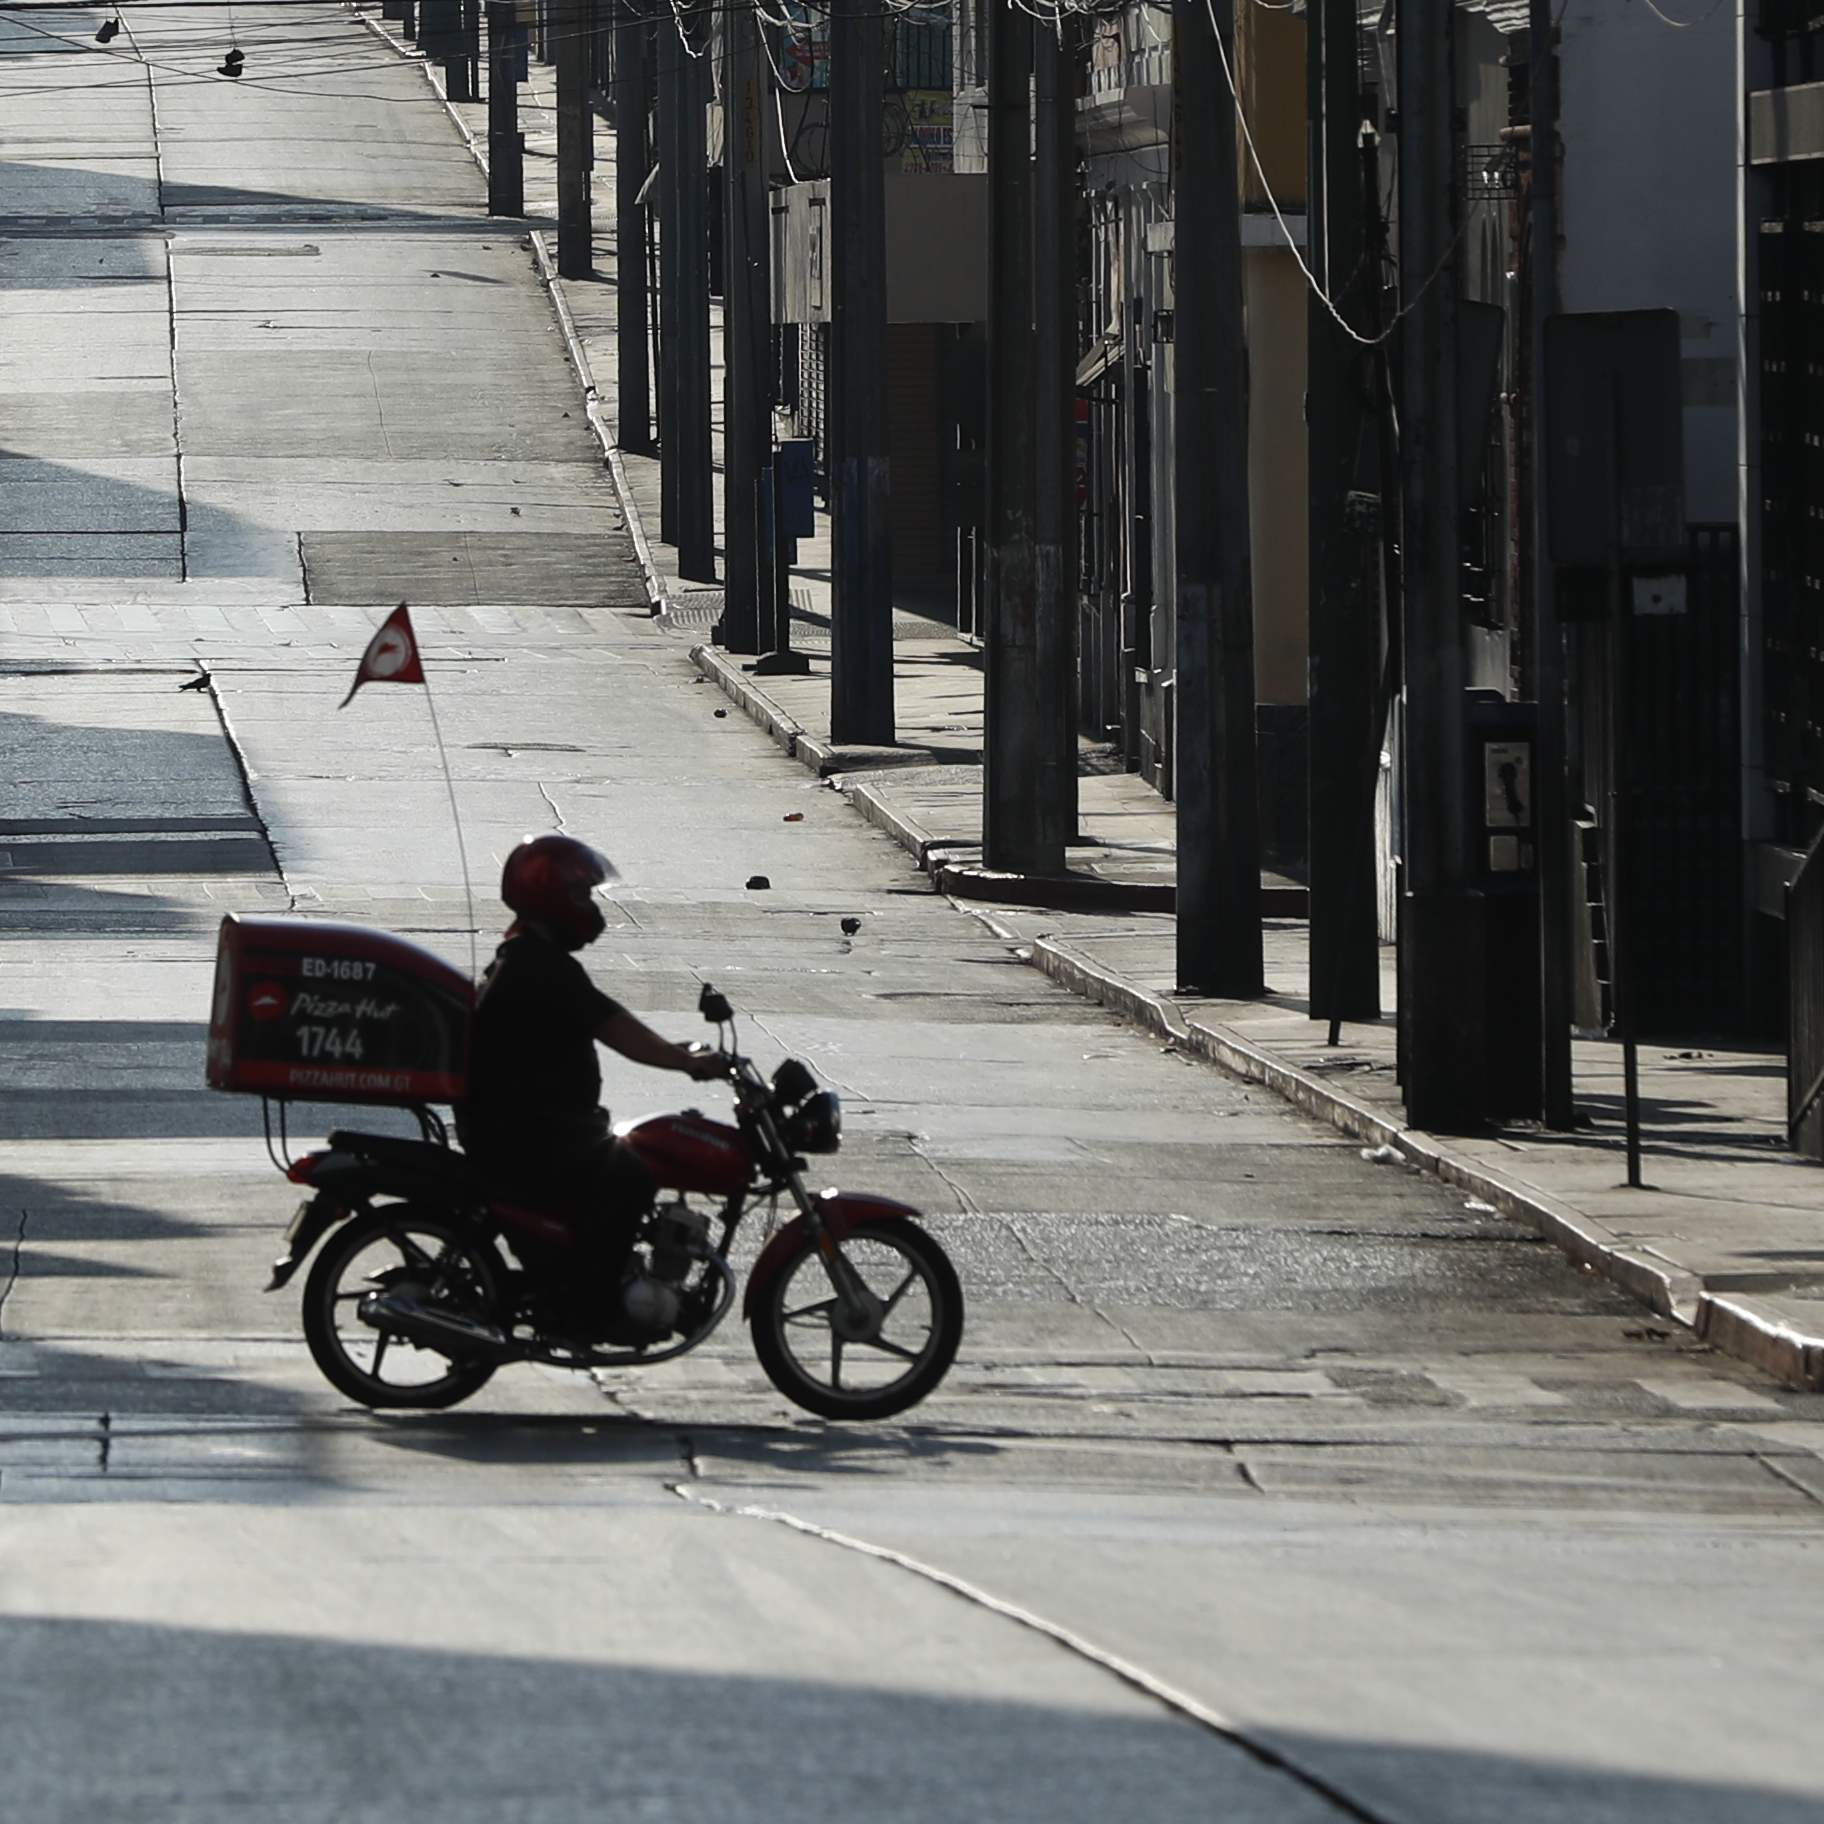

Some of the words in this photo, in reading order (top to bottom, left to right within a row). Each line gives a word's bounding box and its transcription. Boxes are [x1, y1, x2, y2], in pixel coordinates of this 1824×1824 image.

[301, 957, 377, 981] ED-1687
[289, 992, 353, 1018] Pizza
[354, 997, 401, 1019] Hut
[295, 1025, 364, 1060] 1744
